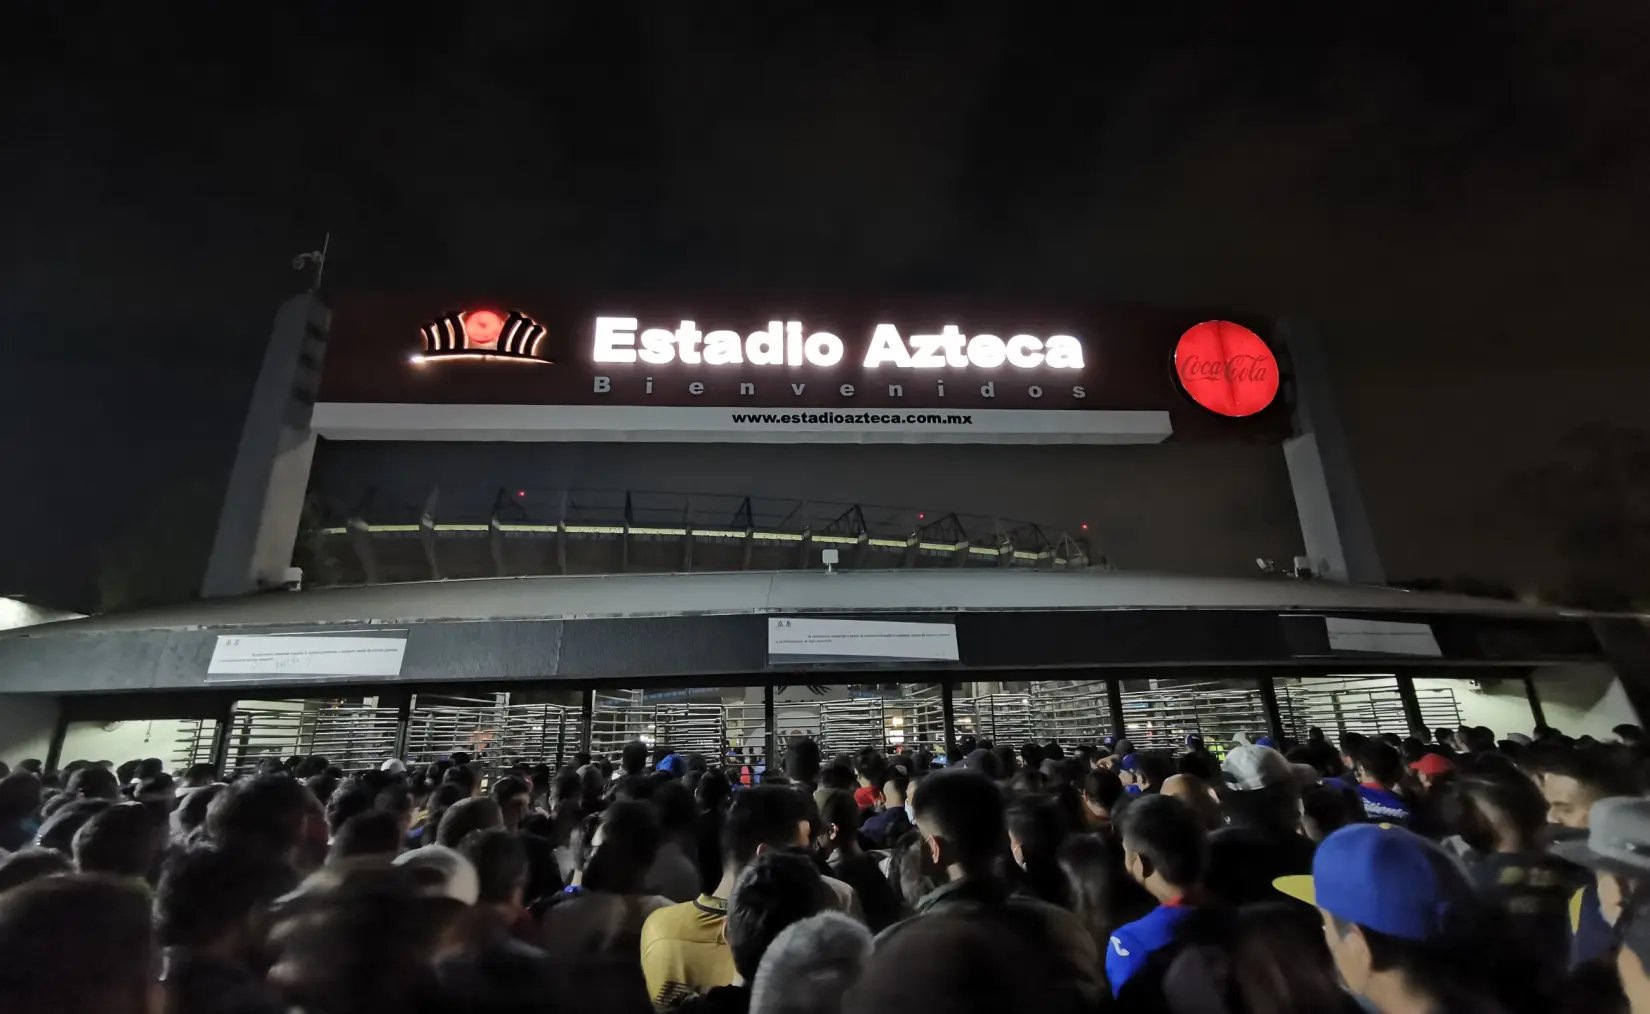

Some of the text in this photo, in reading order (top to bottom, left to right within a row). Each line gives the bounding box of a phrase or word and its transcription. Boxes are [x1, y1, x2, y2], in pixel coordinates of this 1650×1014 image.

[593, 316, 1085, 369] Estadio Azteca
[732, 412, 972, 425] www.estadioazteca.com.mx
